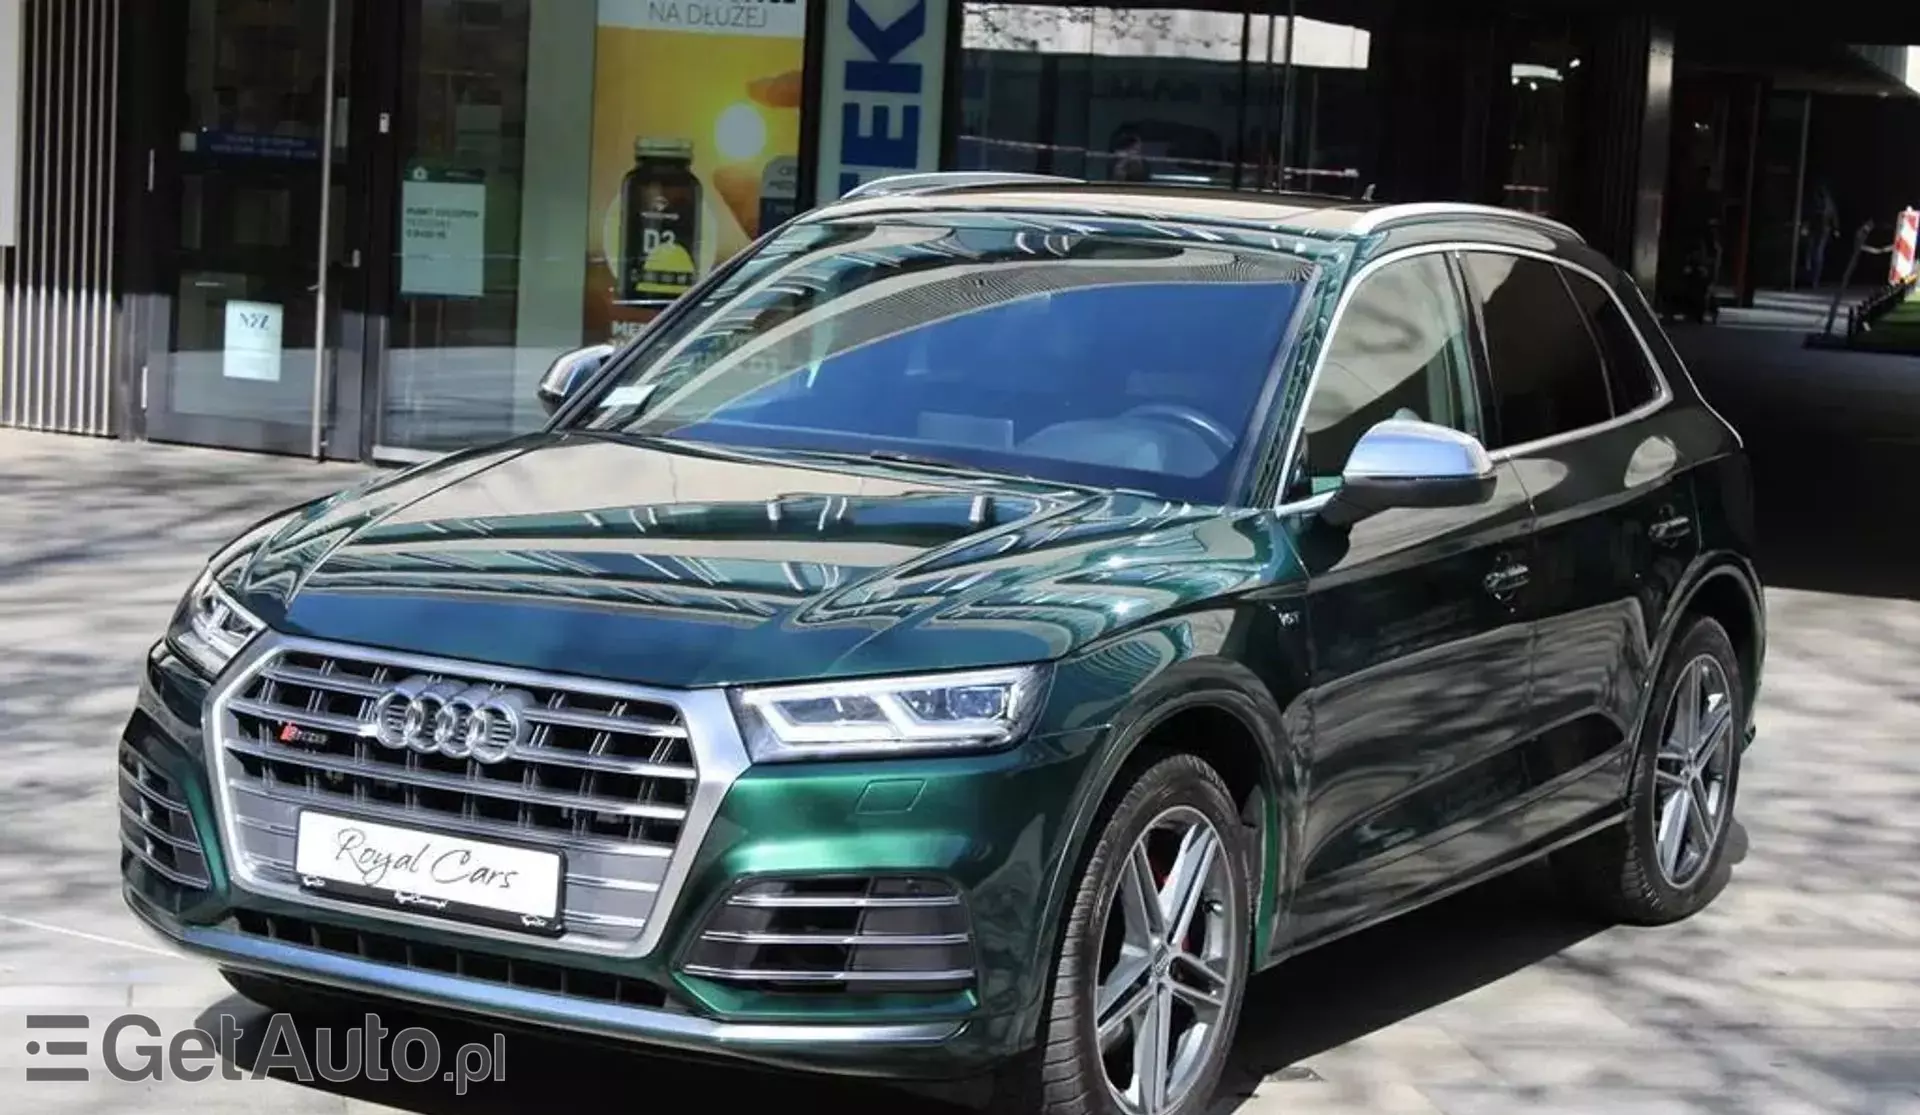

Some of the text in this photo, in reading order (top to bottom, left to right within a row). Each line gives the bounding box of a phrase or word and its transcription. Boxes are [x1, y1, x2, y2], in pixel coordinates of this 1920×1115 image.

[649, 2, 768, 28] NA DŁUŻEJ
[838, 0, 926, 200] EK
[334, 827, 520, 890] Royal Cars
